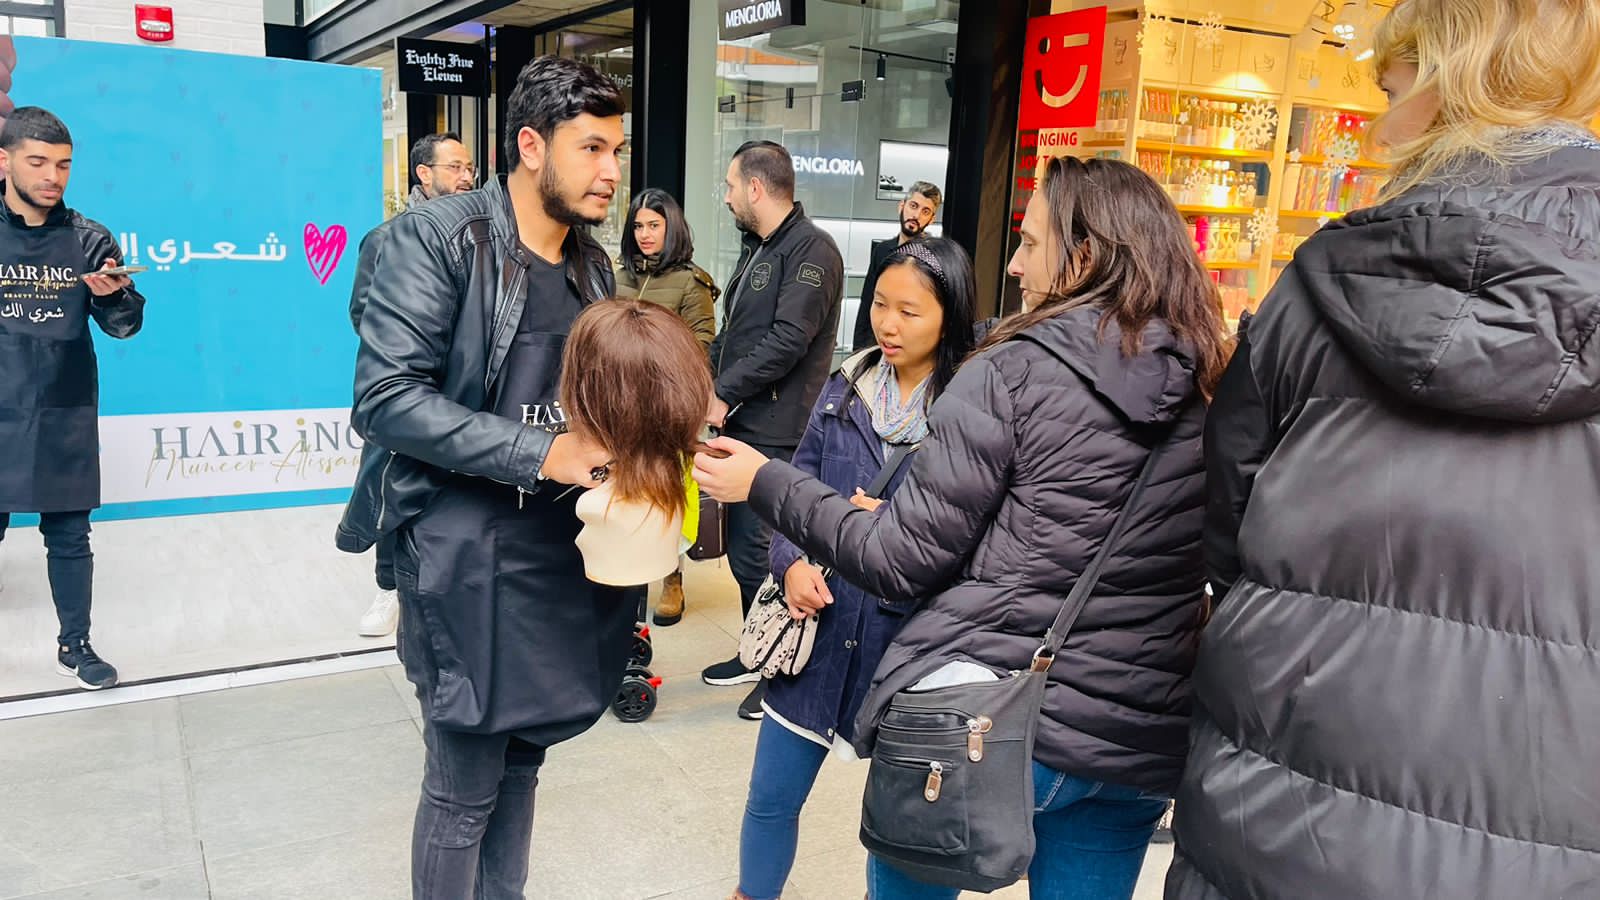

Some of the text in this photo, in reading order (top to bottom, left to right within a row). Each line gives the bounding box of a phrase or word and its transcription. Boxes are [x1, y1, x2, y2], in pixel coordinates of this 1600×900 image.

[725, 0, 782, 28] MENGLORIA
[405, 49, 474, 70] Eighty Five
[423, 67, 463, 83] Eleven
[791, 155, 864, 176] ENGLORIA
[147, 232, 287, 272] شعري
[28, 306, 65, 323] شعري
[520, 401, 567, 426] HAi
